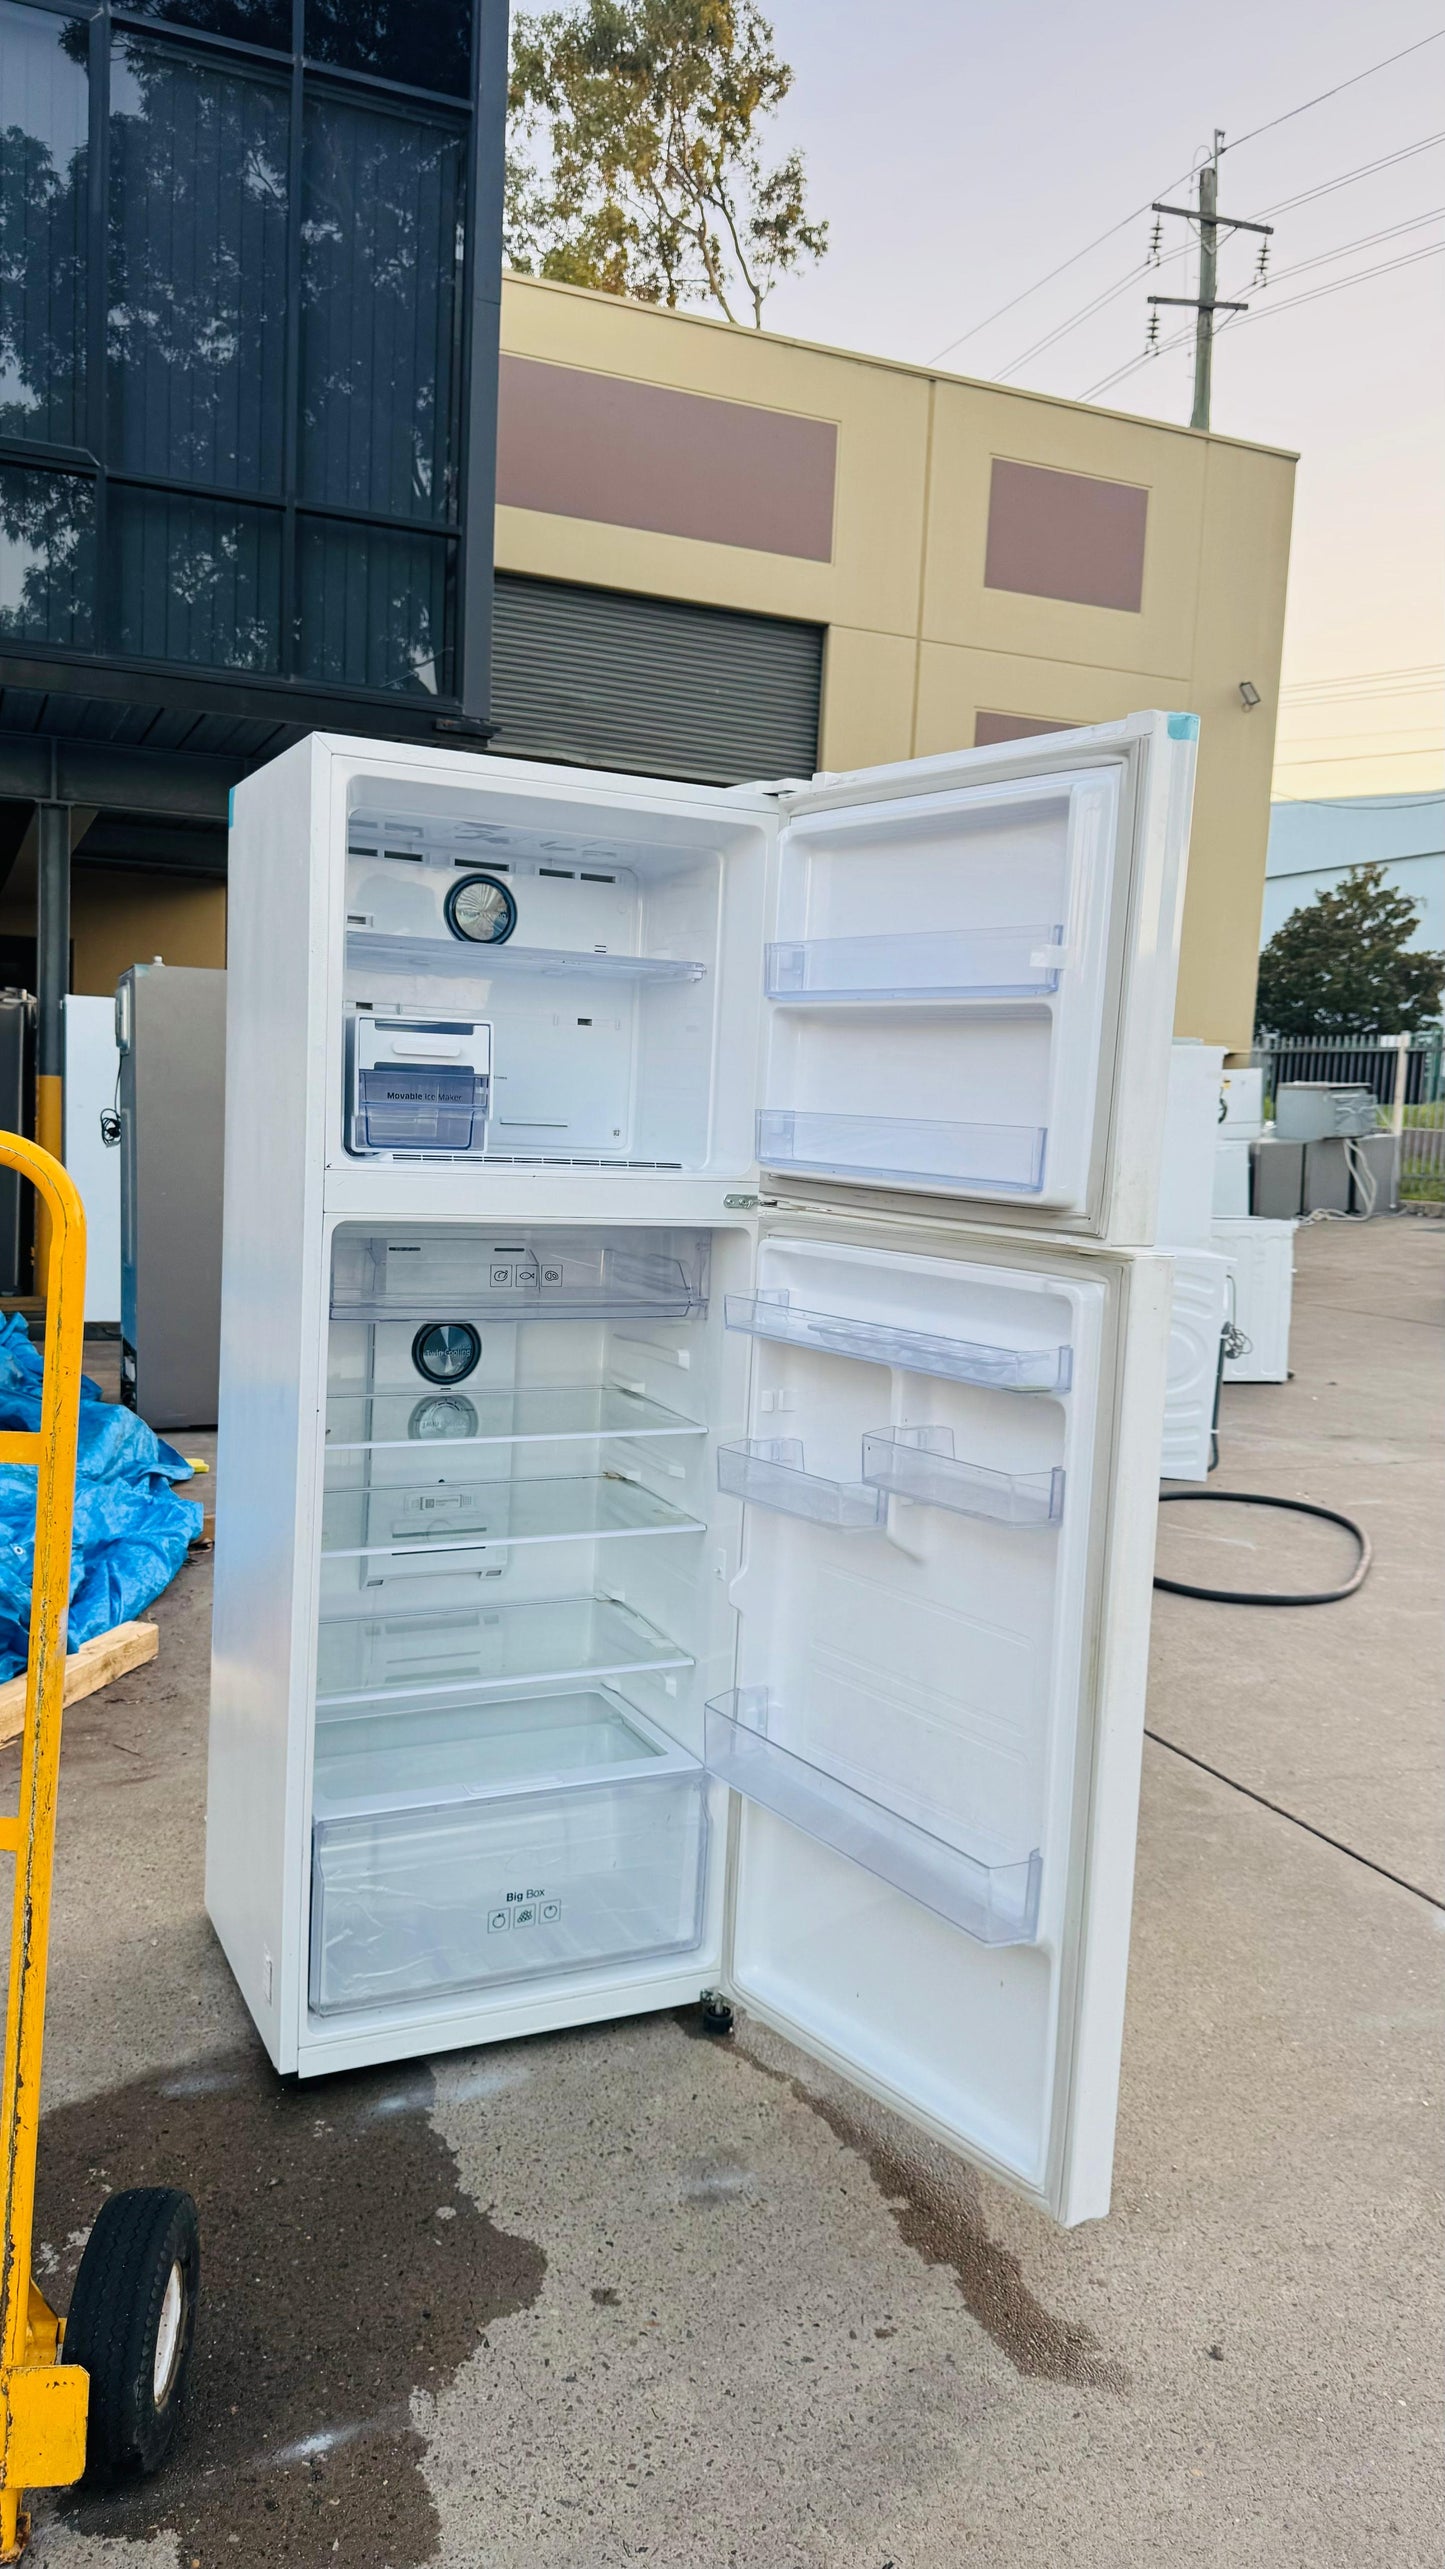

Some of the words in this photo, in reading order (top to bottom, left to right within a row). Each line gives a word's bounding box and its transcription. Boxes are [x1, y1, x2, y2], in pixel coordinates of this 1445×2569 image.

[387, 1091, 423, 1100] Movable
[425, 1092, 436, 1101] Ice
[438, 1093, 462, 1101] Maker
[506, 1891, 523, 1902] Big
[526, 1889, 545, 1899] Box
